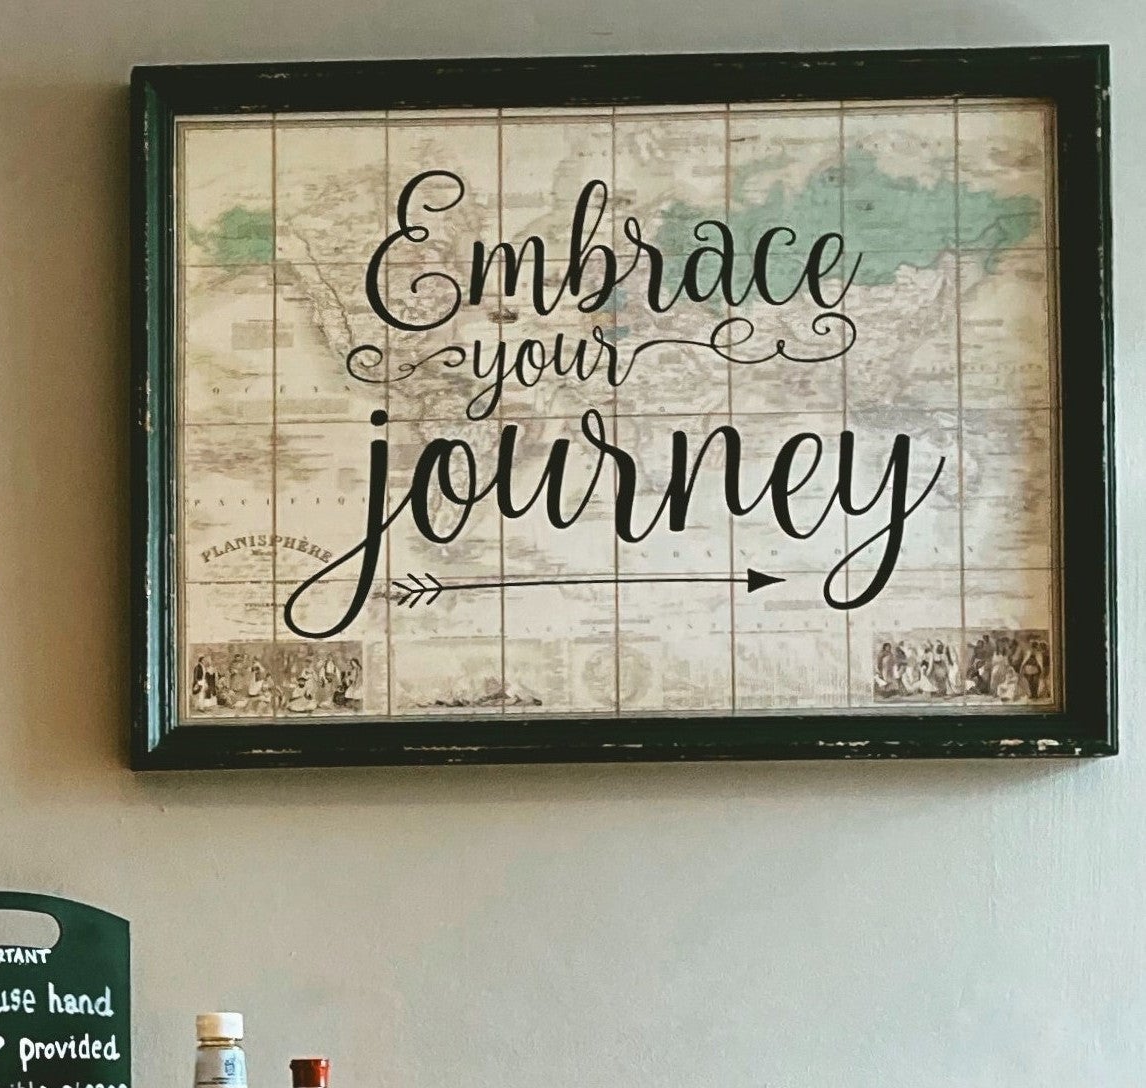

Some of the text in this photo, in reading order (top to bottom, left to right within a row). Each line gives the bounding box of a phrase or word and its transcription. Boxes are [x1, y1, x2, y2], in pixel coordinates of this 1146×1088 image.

[365, 170, 863, 332] Embrace
[465, 326, 638, 421] your
[284, 409, 946, 639] journey
[48, 982, 114, 1017] hand
[19, 1033, 121, 1072] provided
